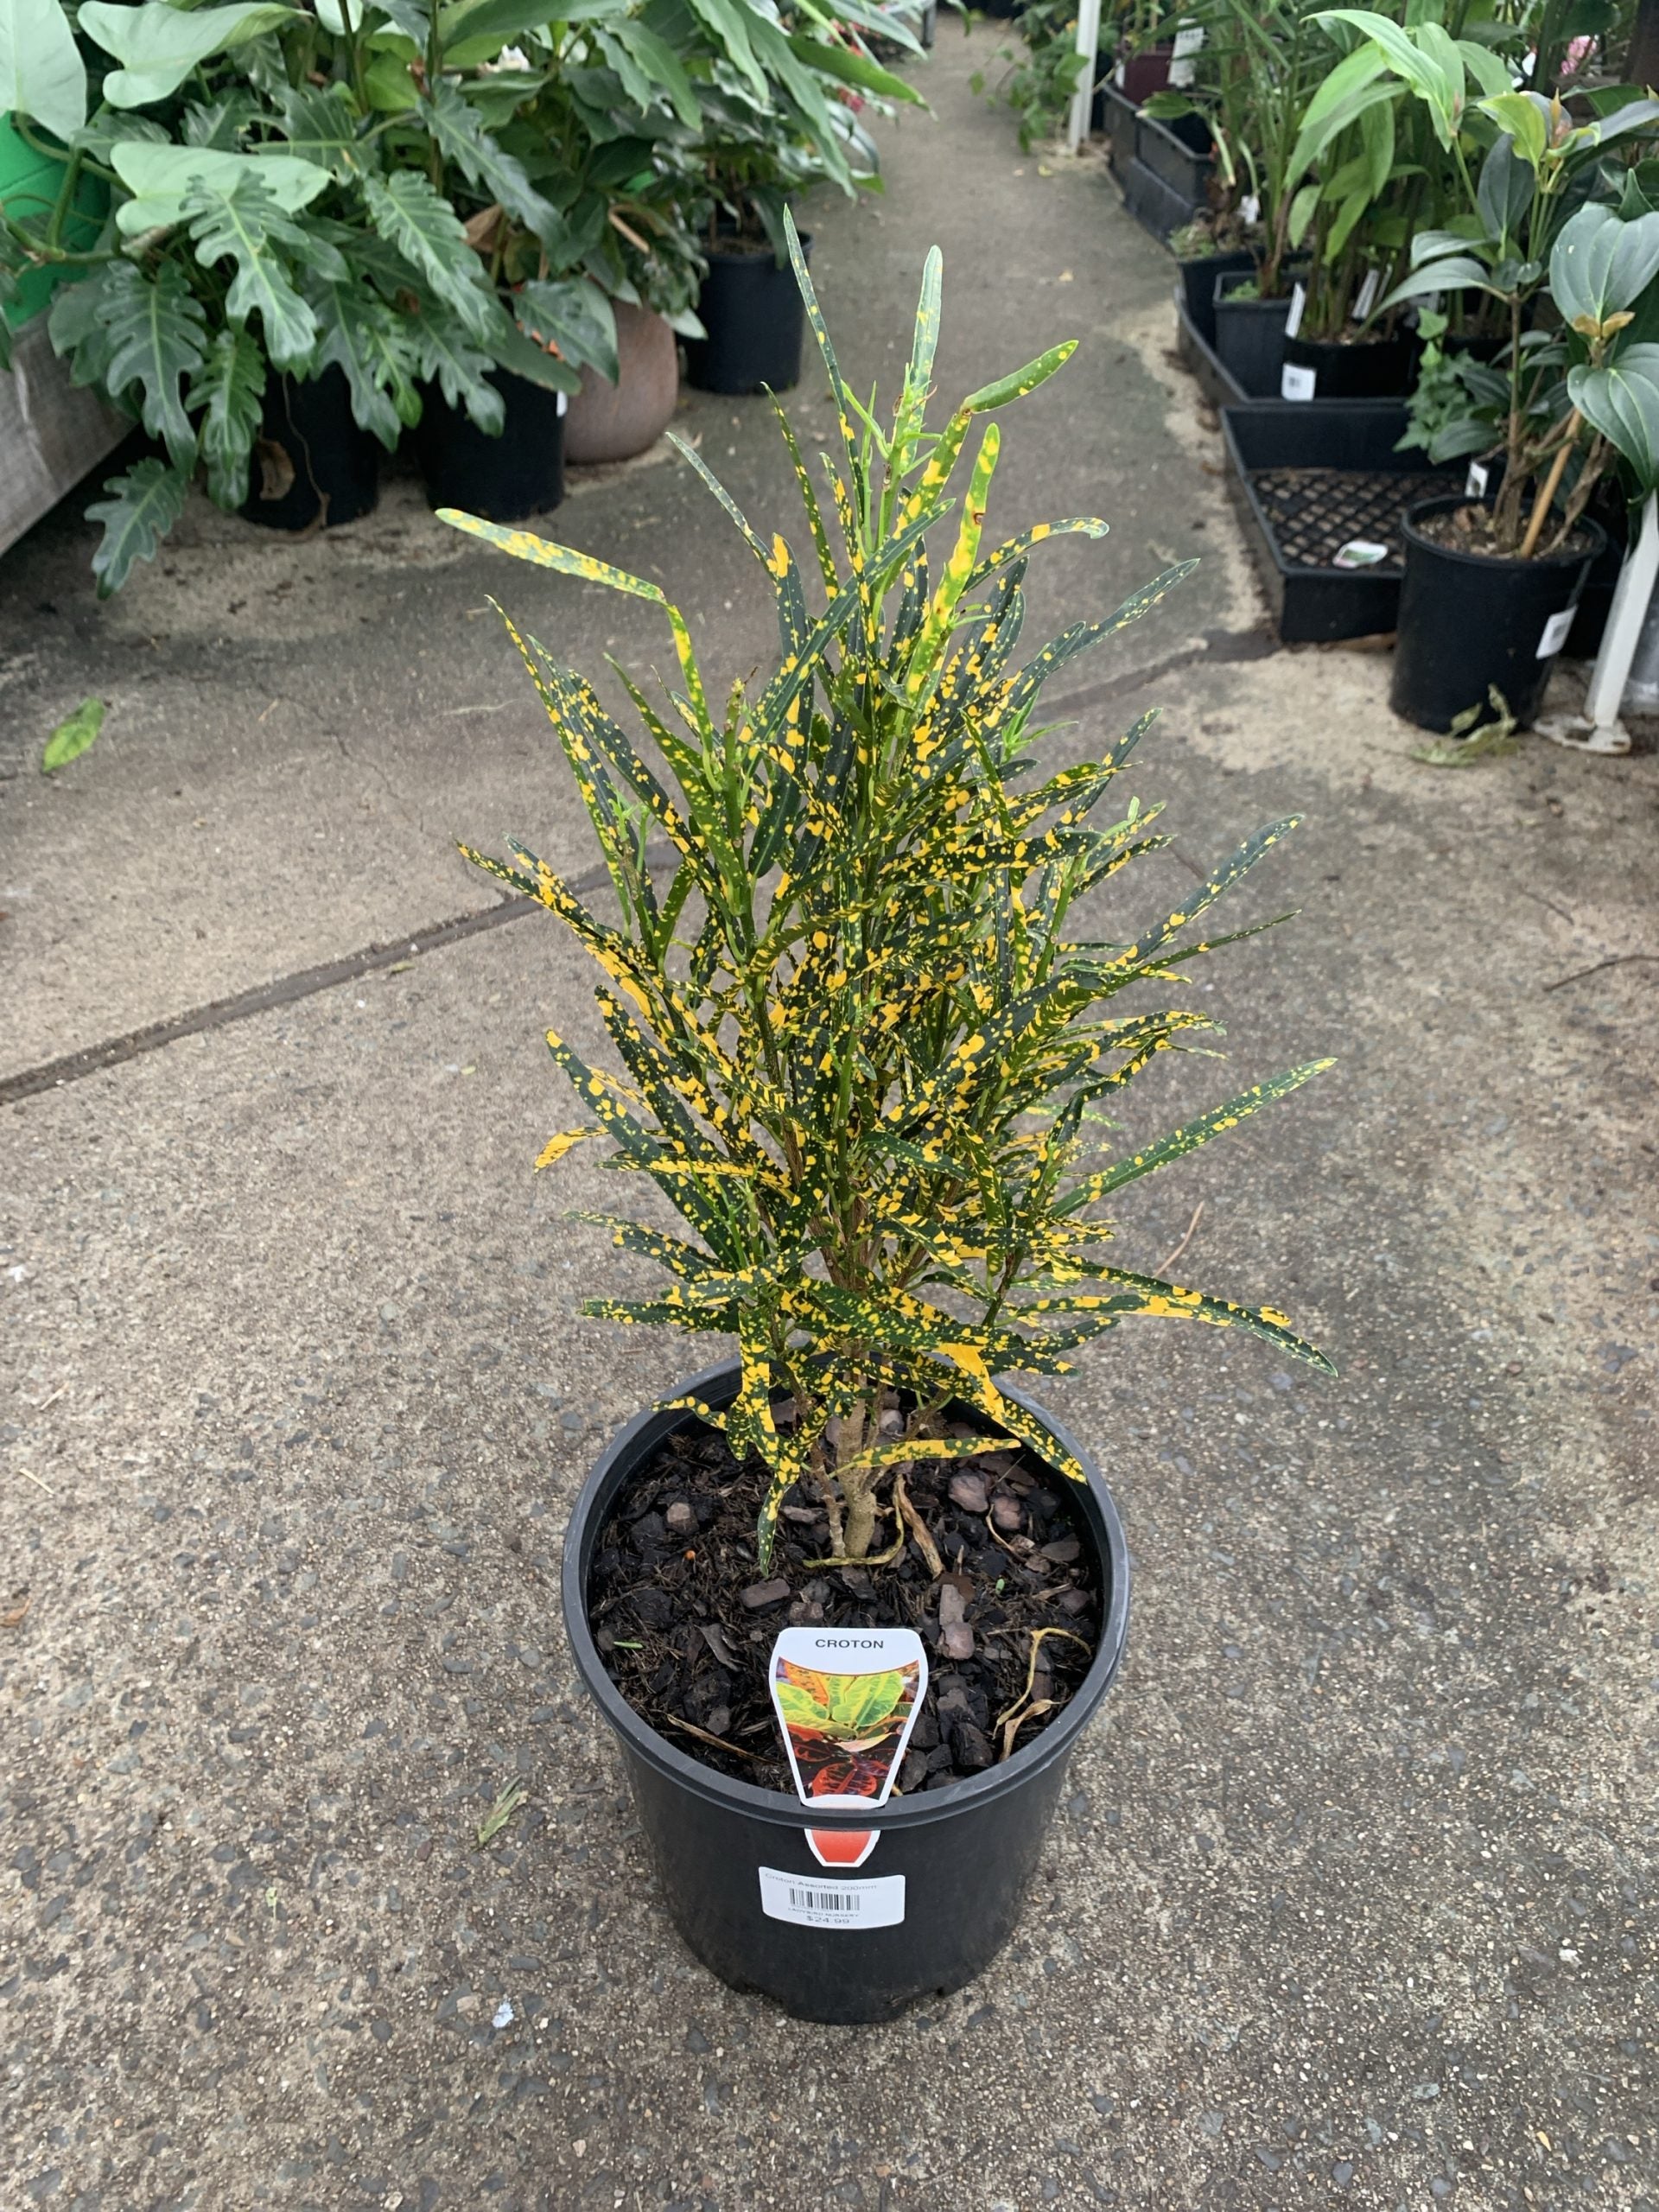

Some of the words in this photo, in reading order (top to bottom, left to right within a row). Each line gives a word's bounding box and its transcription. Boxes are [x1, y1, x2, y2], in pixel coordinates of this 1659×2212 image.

[815, 1639, 884, 1649] CROTON
[765, 1872, 795, 1885] Croton
[798, 1881, 839, 1891] Assorted
[806, 1915, 850, 1923] $24.99
